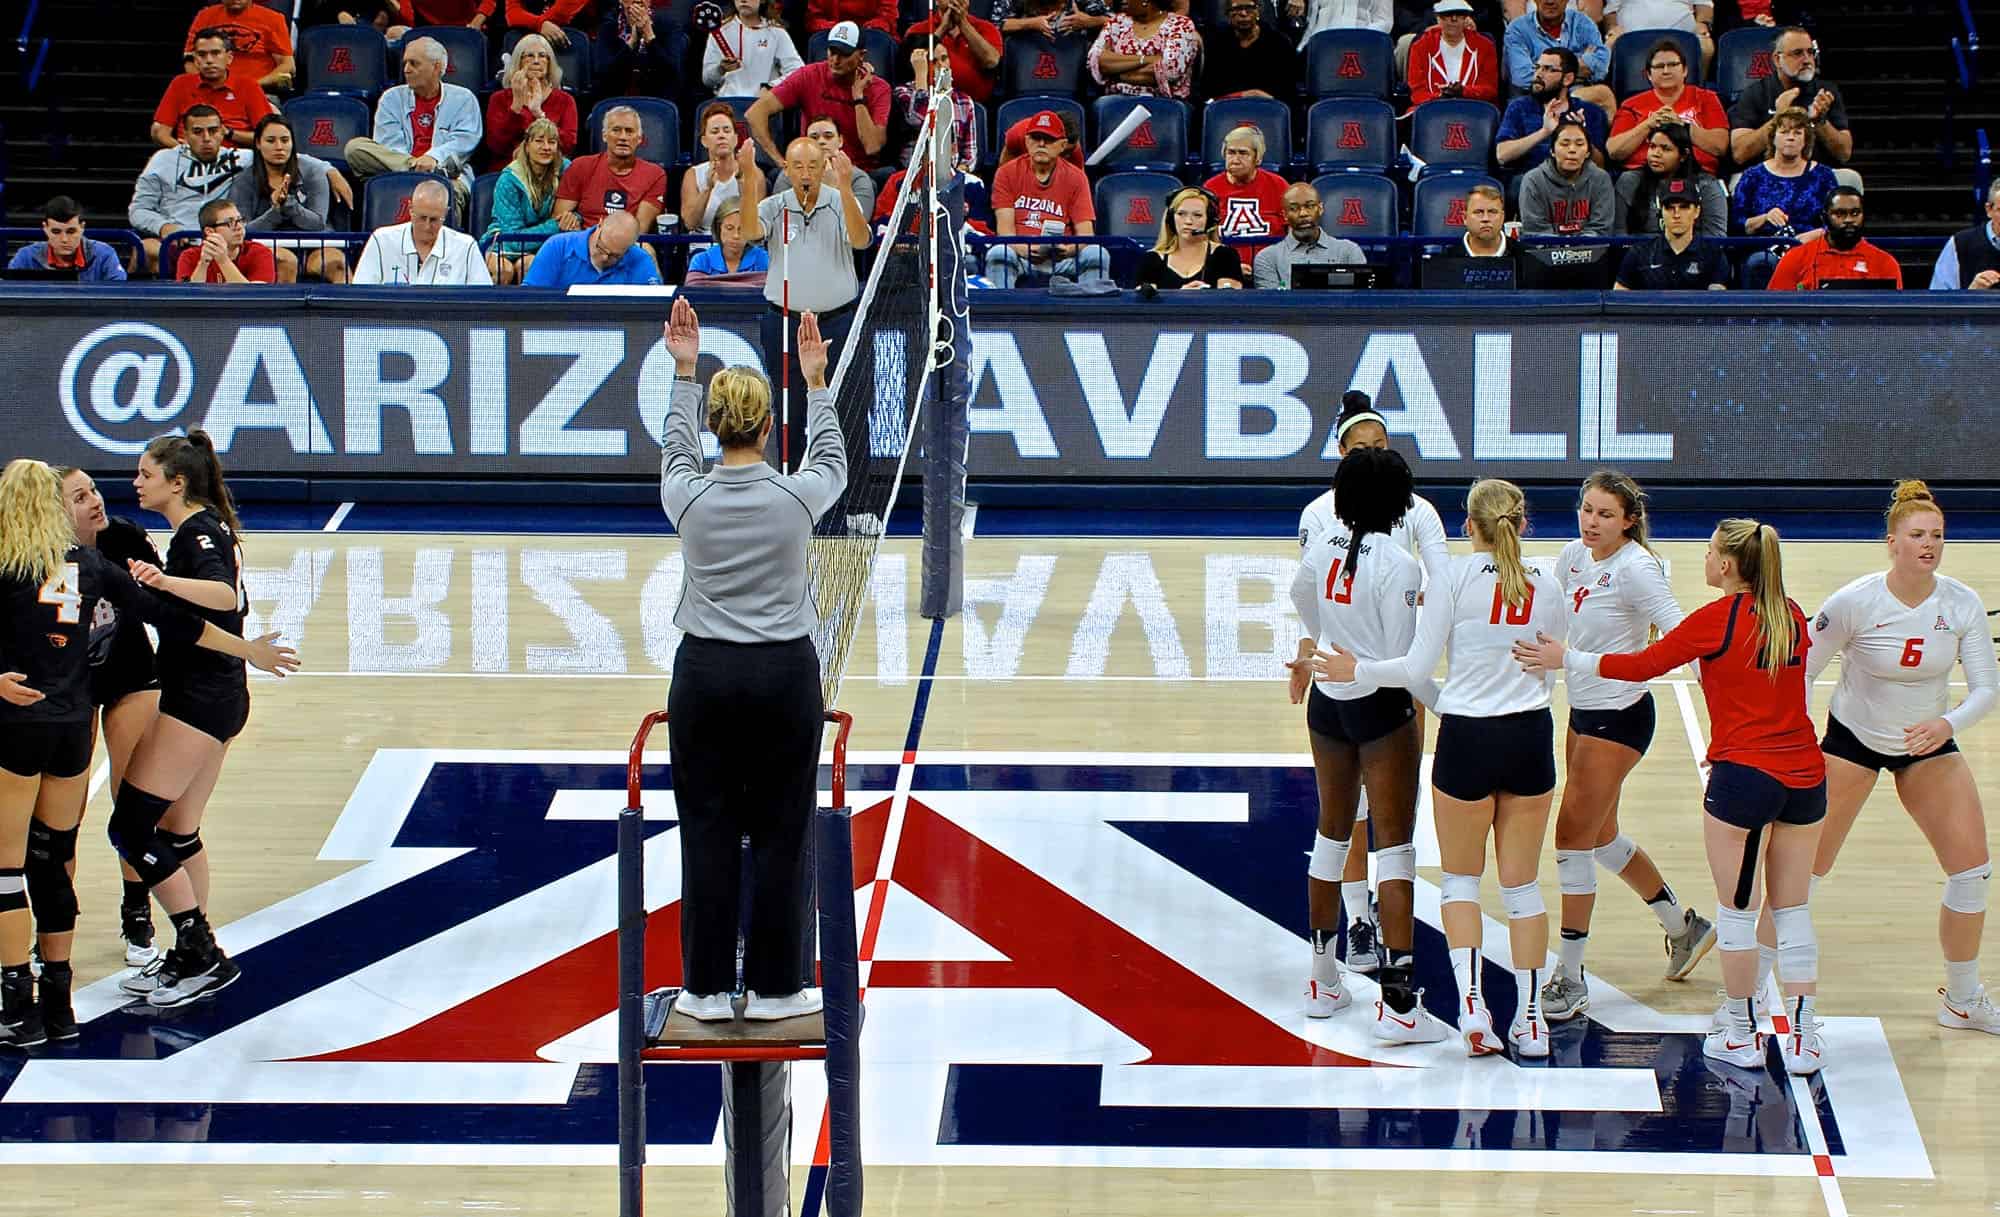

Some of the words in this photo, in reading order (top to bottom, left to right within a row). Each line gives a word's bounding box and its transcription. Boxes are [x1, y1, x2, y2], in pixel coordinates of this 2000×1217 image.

[1218, 198, 1270, 237] A
[196, 534, 214, 549] 2
[38, 562, 81, 624] 4
[1900, 638, 1924, 667] 6
